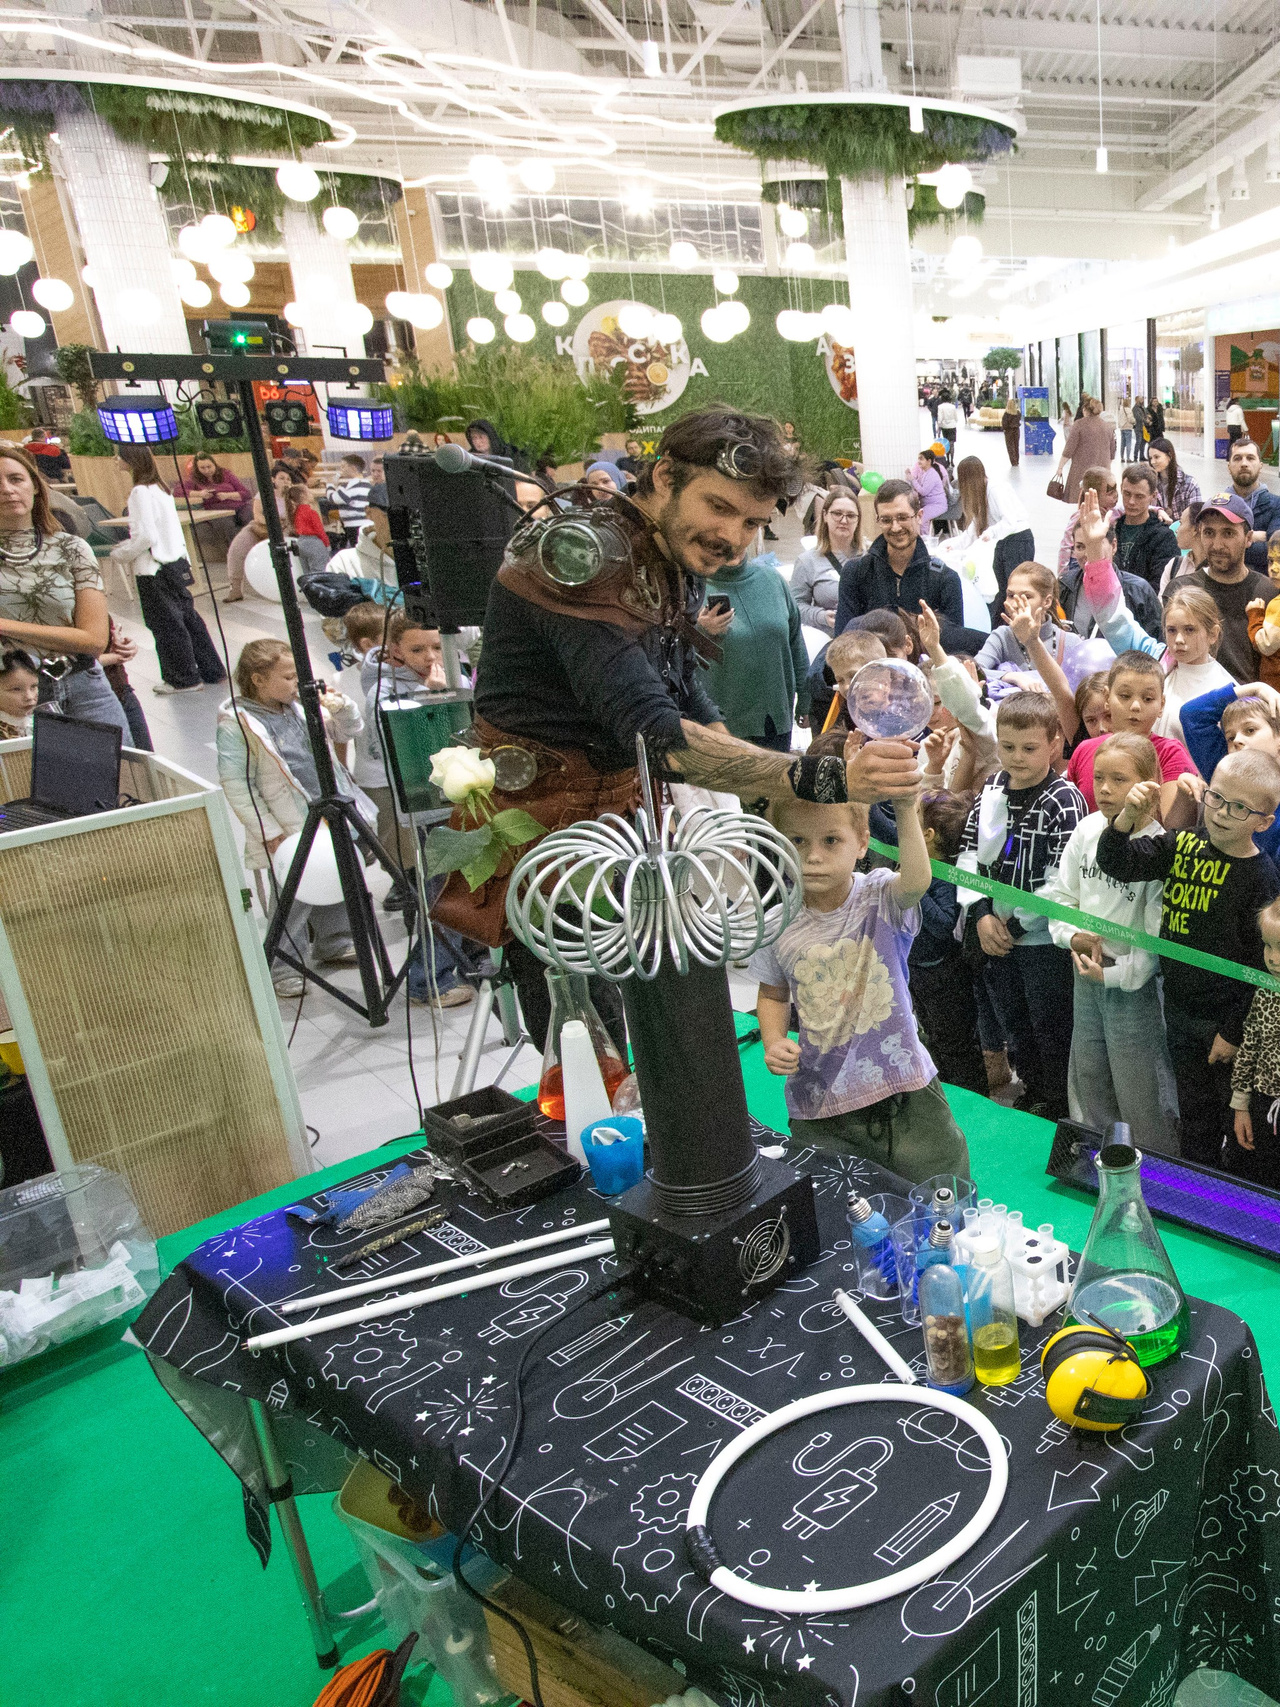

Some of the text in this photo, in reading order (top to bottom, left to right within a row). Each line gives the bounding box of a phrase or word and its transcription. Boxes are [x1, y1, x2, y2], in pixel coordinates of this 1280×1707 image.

[1191, 858, 1231, 885] YOU
[959, 874, 994, 892] ОДИПАРК
[1095, 921, 1136, 942] ОДИПАРК
[1168, 910, 1190, 934] ME
